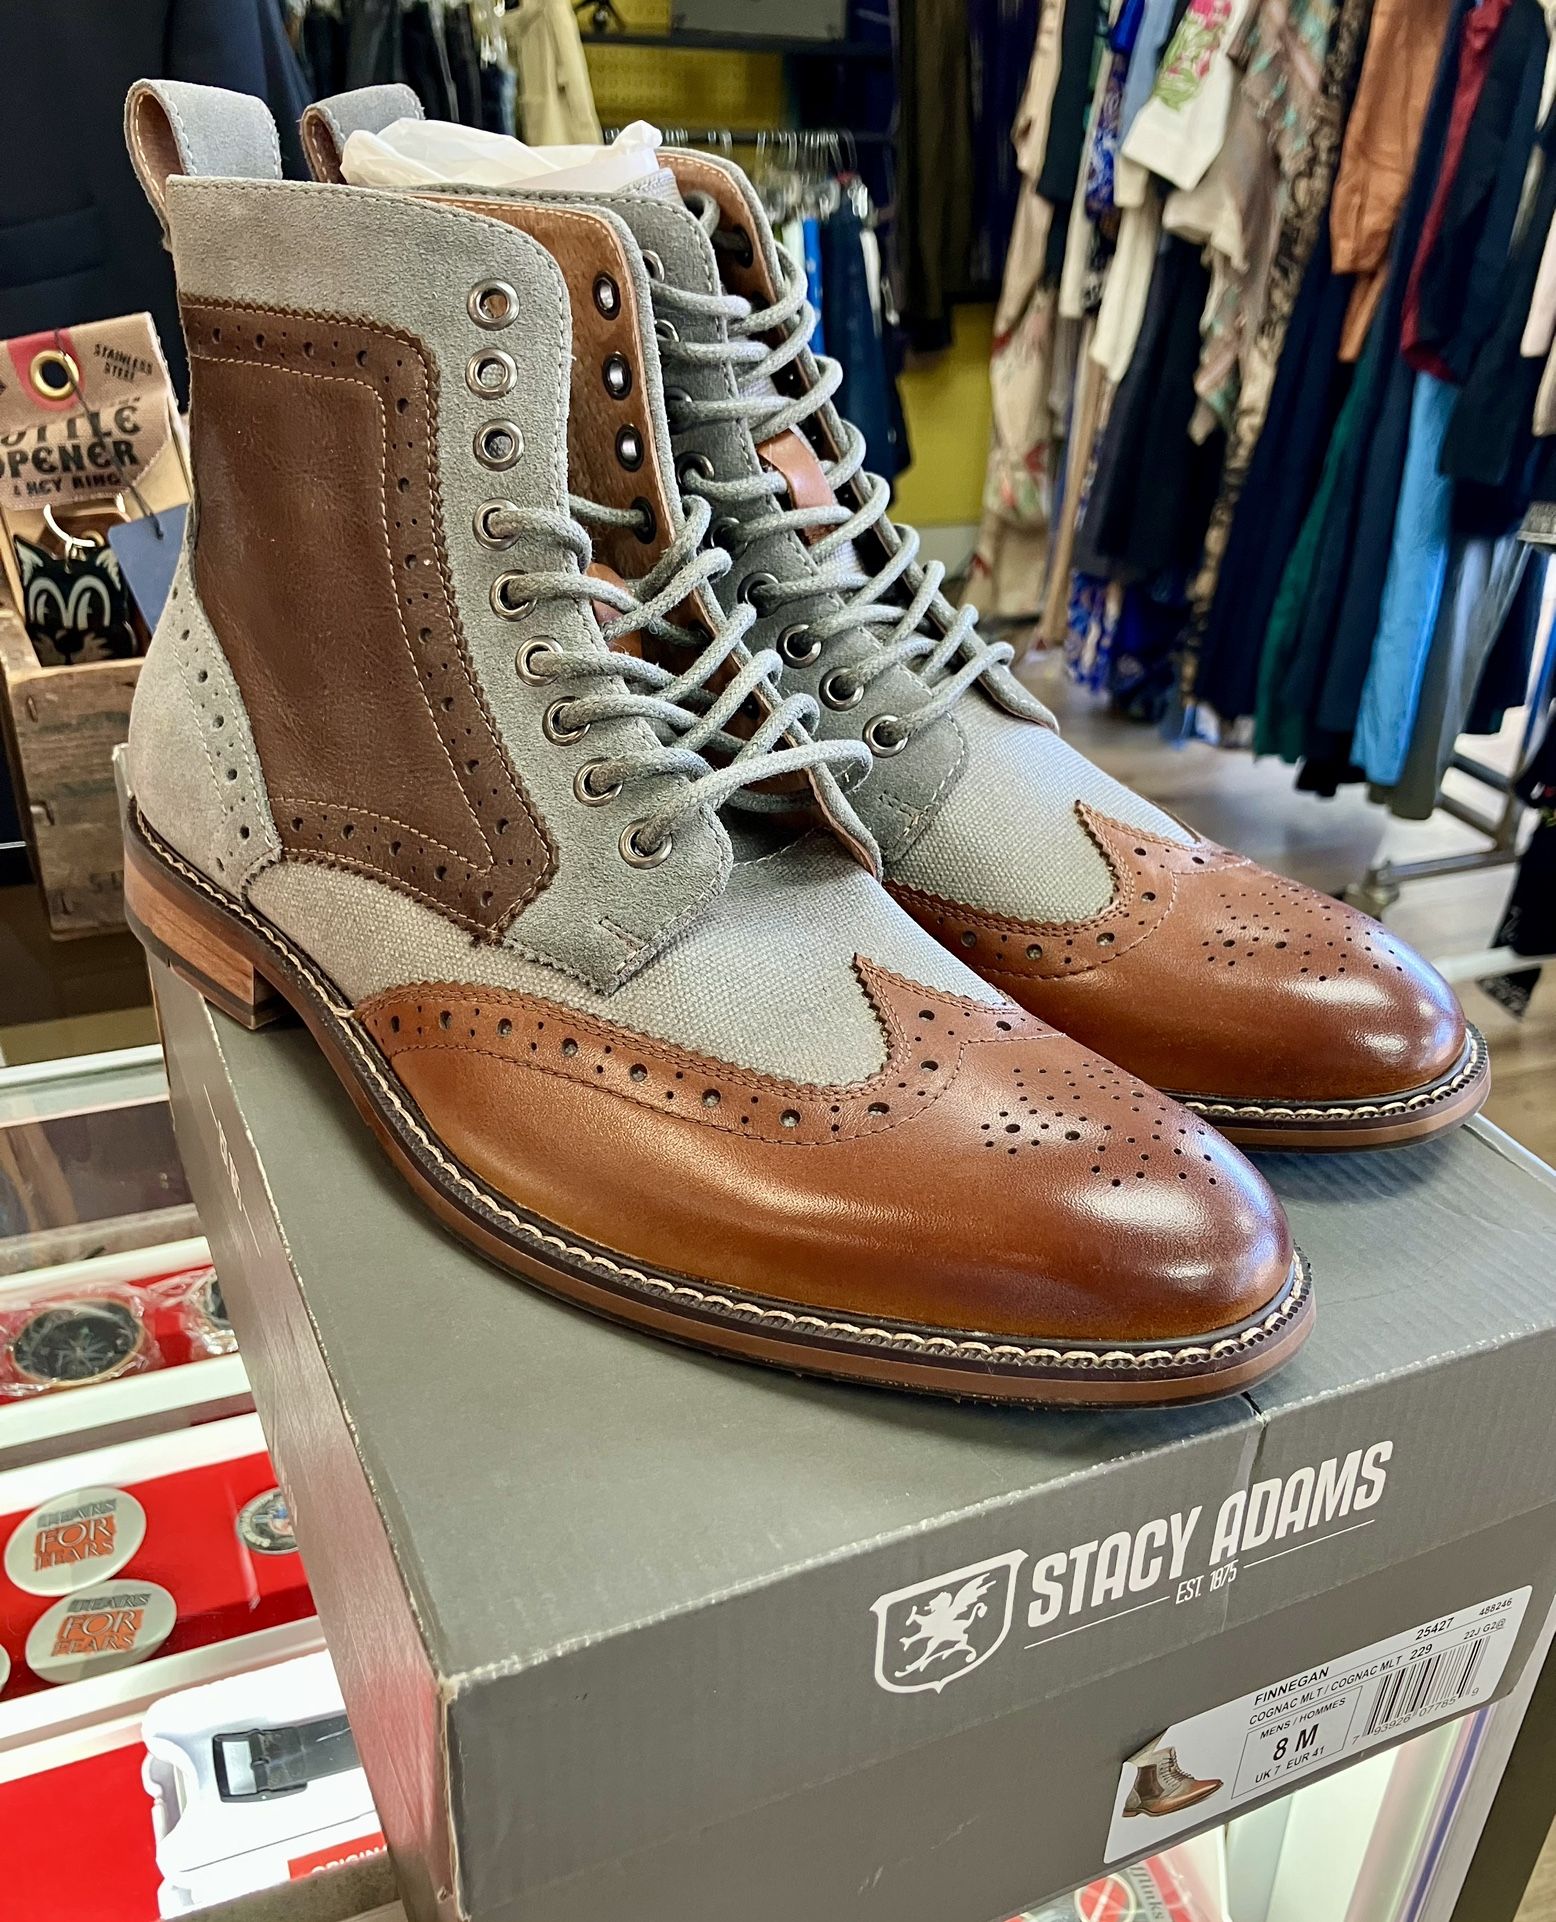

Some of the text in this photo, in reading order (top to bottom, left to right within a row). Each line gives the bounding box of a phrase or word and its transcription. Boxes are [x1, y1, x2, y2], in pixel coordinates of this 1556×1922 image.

[38, 1516, 112, 1552] FOR
[1027, 1440, 1394, 1628] STACY ADAMS
[1209, 1559, 1239, 1593] 1875
[62, 1610, 137, 1639] FOR
[1254, 1597, 1513, 1706] FINNEGAN 25427 488246
[1249, 1698, 1298, 1725] COGNAC
[1300, 1687, 1323, 1704] MLT
[1331, 1665, 1378, 1692] COGNAC
[1379, 1655, 1403, 1671] MLT
[1409, 1643, 1433, 1661] 229
[1260, 1721, 1291, 1740] MENS
[1299, 1698, 1346, 1723] HOMMES
[1351, 1687, 1480, 1745] 7 93926 07785 9
[1273, 1723, 1320, 1761] 8 M
[1255, 1745, 1325, 1784] UK 7 EUR 41
